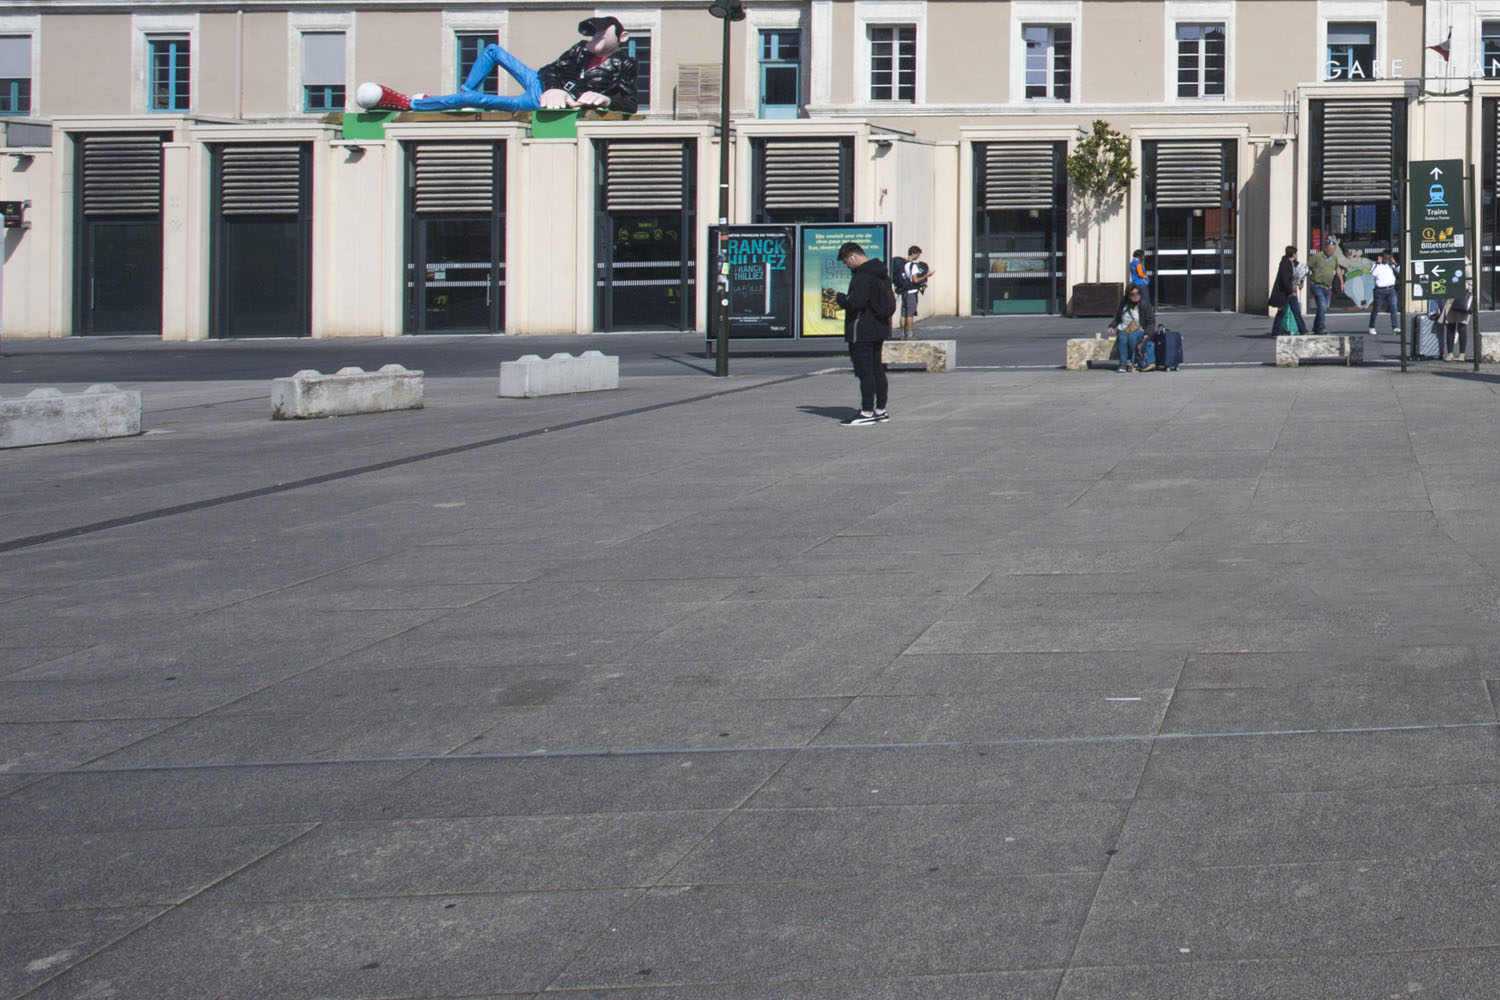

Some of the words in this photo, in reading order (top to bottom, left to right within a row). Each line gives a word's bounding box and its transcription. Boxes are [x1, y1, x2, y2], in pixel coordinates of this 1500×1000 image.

[1323, 60, 1404, 79] GARE
[728, 239, 786, 254] RANCK
[728, 254, 786, 270] HIIEZ
[734, 272, 764, 280] THILLIEZ
